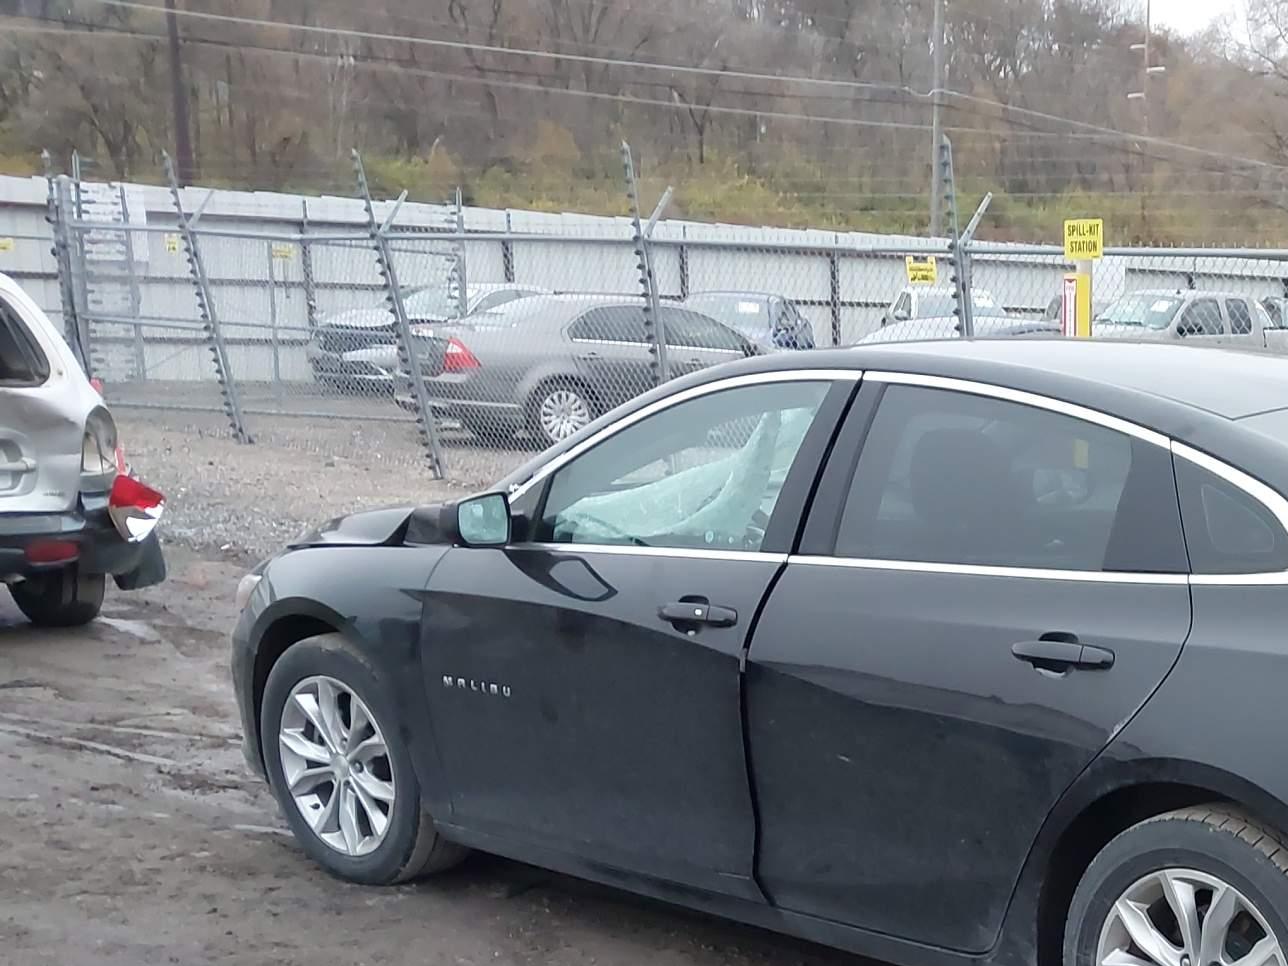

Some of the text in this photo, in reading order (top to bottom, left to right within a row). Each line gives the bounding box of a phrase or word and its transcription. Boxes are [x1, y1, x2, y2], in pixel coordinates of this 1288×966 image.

[1067, 223, 1100, 237] SPILL-KIT
[1069, 240, 1098, 253] STATION
[442, 674, 511, 697] MALIBU
